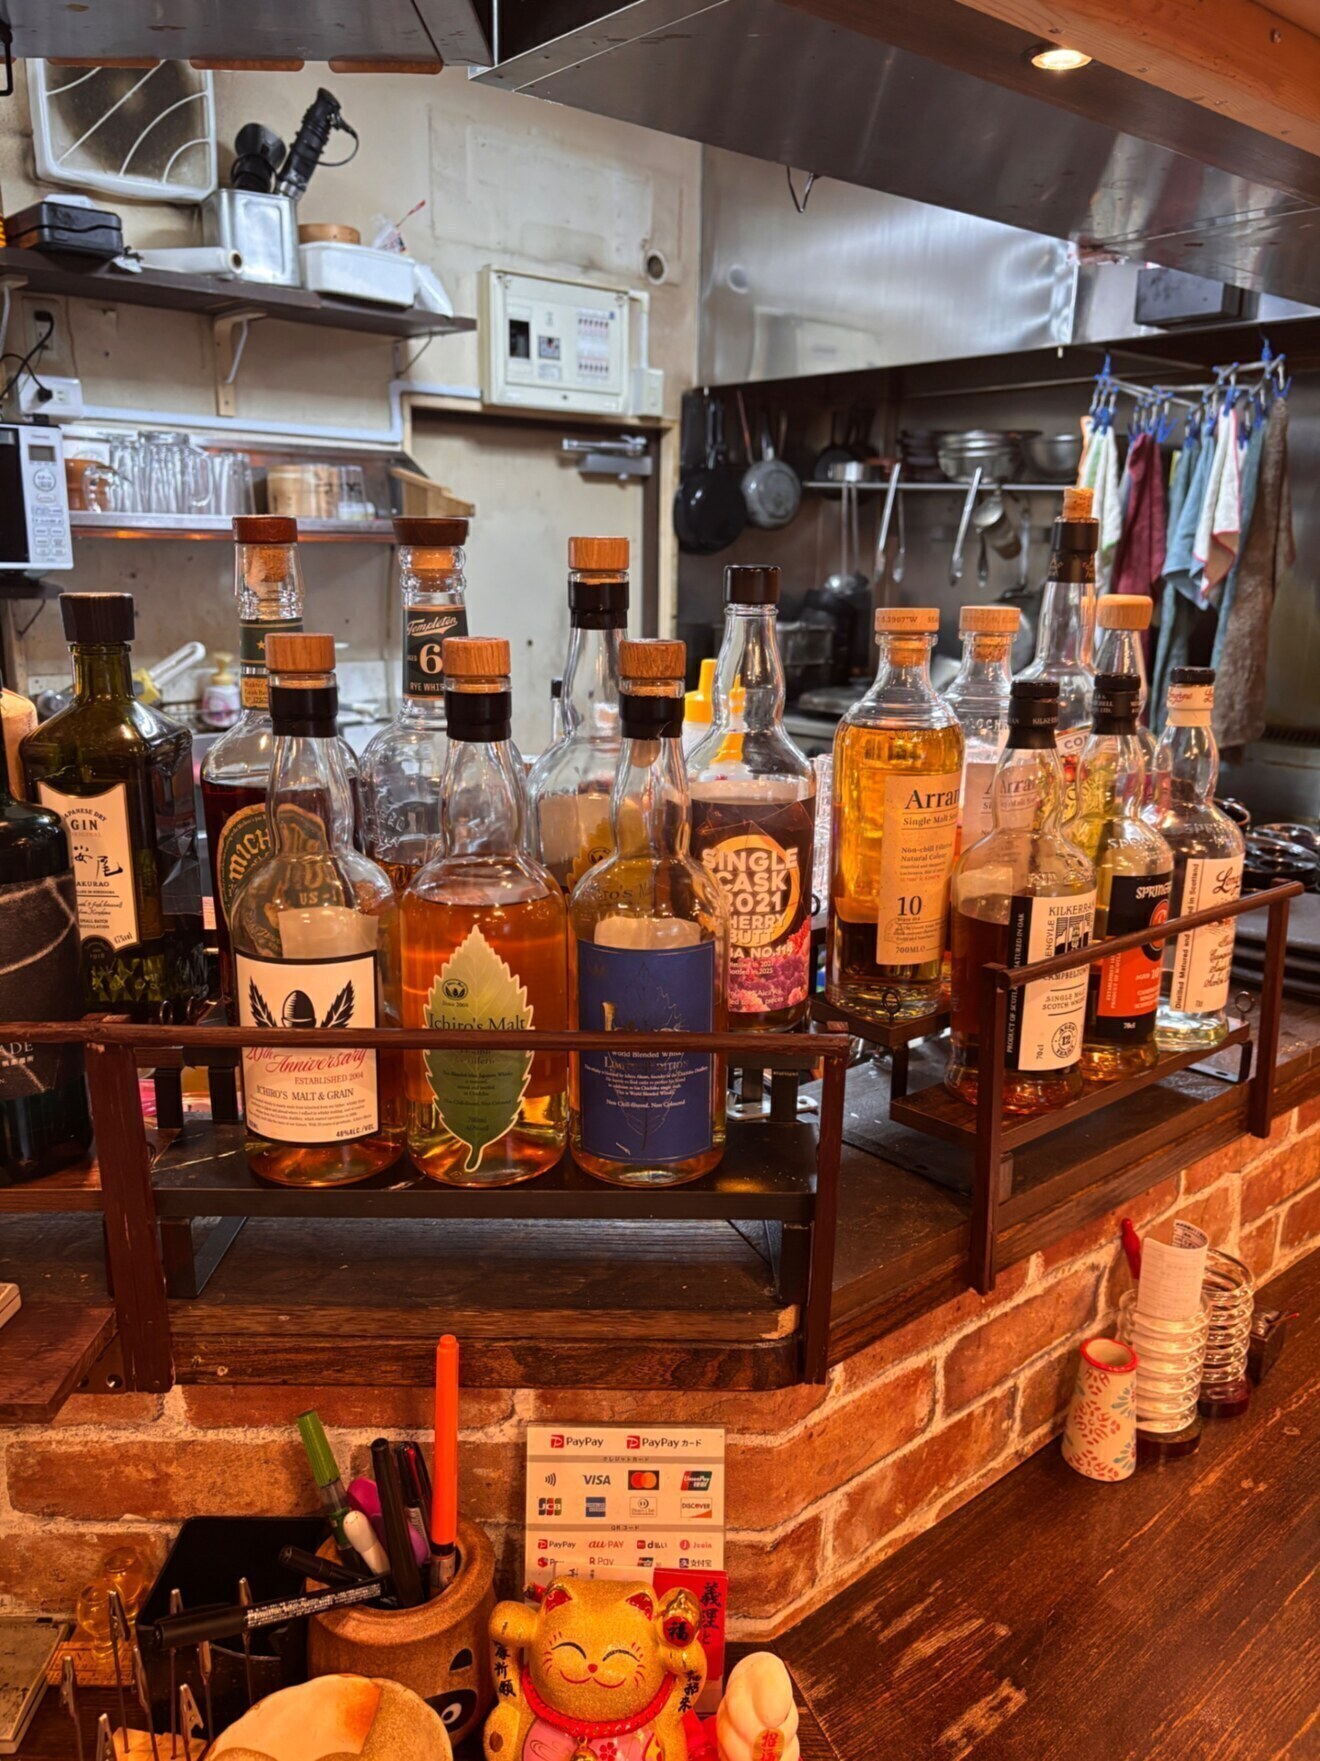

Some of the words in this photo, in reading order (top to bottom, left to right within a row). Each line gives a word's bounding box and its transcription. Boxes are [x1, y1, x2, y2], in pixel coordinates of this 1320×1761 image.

[420, 643, 443, 674] 6
[64, 808, 93, 818] APANESE
[71, 819, 98, 831] GIN
[229, 829, 271, 880] MICH
[702, 847, 799, 872] SINGLE
[715, 871, 787, 893] CASK
[1189, 863, 1199, 896] Scotland
[897, 895, 922, 916] 10
[1187, 897, 1194, 905] in
[727, 914, 786, 930] HERRY
[1017, 913, 1025, 930] OAK
[729, 929, 775, 944] BUTT
[1045, 920, 1055, 957] ENGYLE
[1179, 949, 1189, 979] Matured
[1175, 982, 1184, 1008] Distilled
[489, 1014, 526, 1030] Malt
[1009, 1013, 1016, 1022] OF
[1006, 1023, 1016, 1053] PRODUCT
[1062, 1035, 1072, 1046] 12
[265, 1048, 368, 1073] Anniversary
[294, 1075, 348, 1085] ESTABLISHED
[349, 1072, 364, 1081] 2004
[256, 1084, 289, 1100] ICHIRO'S
[291, 1090, 317, 1101] MALT
[317, 1091, 326, 1101] &
[326, 1088, 354, 1101] GRAIN
[566, 1437, 604, 1448] PayPay
[642, 1438, 680, 1448] PayPay
[681, 1439, 702, 1448] カード
[583, 1475, 611, 1485] VISA
[540, 1502, 562, 1512] JCB
[549, 1541, 577, 1549] PayPay
[608, 1541, 625, 1549] PAY
[589, 1557, 596, 1566] R
